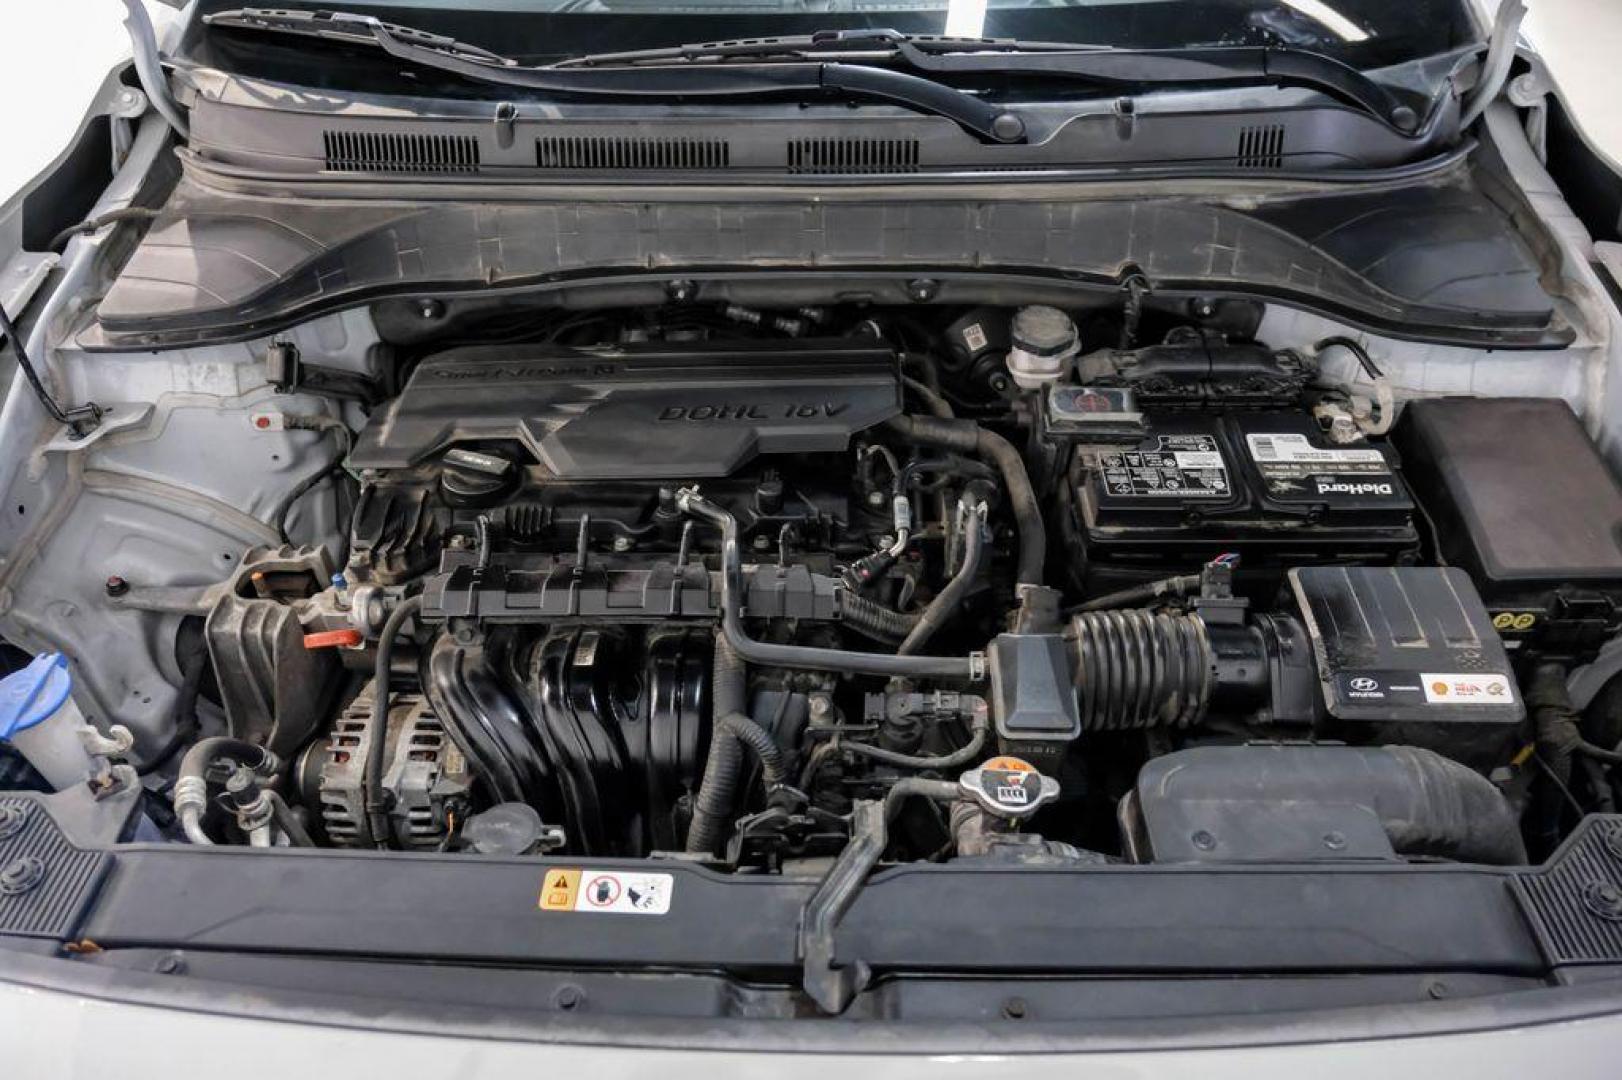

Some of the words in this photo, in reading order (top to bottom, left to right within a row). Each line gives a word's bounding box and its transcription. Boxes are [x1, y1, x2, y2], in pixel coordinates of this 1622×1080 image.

[657, 403, 769, 422] DOHC
[785, 402, 851, 420] 16V
[1317, 483, 1393, 495] DieHard
